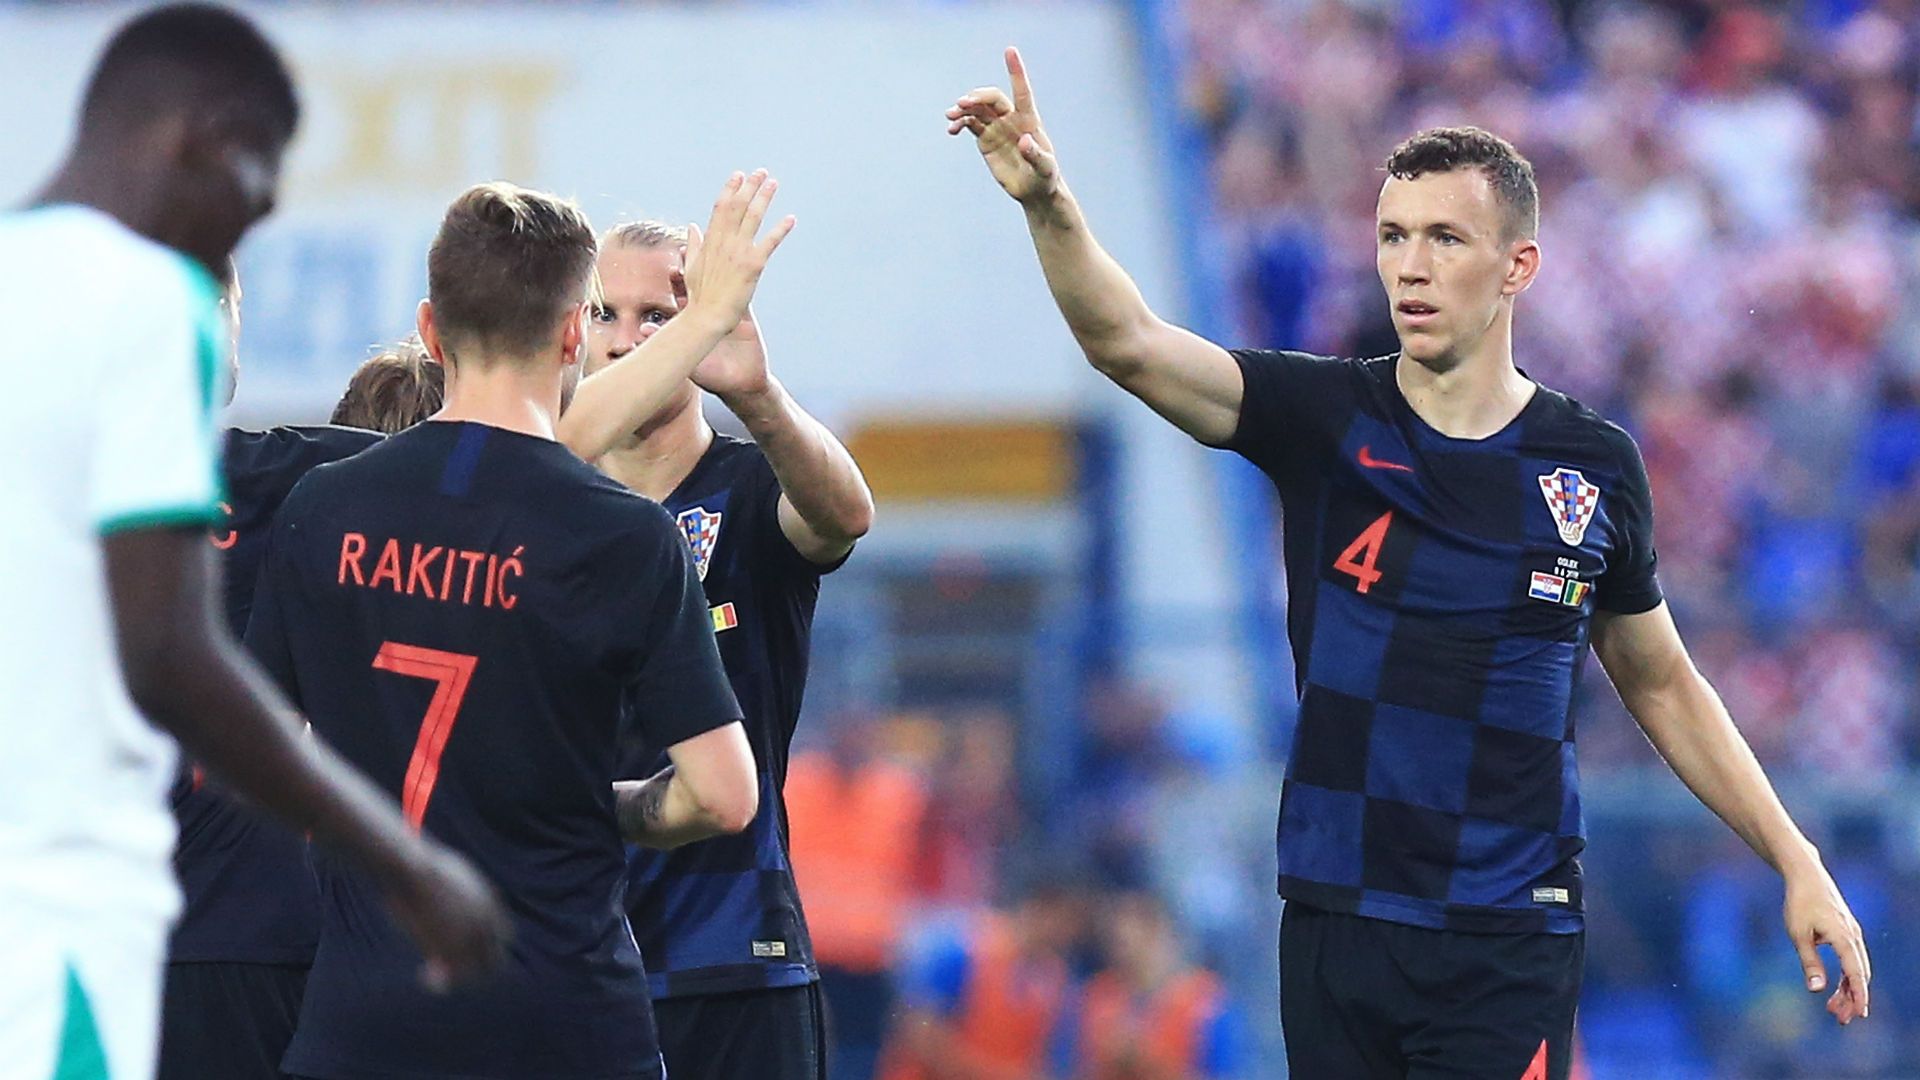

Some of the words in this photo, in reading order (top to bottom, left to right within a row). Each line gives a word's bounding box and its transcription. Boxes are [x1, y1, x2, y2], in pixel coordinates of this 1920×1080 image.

[337, 533, 524, 610] RAKITIĆ
[1333, 510, 1393, 594] 4
[371, 640, 479, 838] 7
